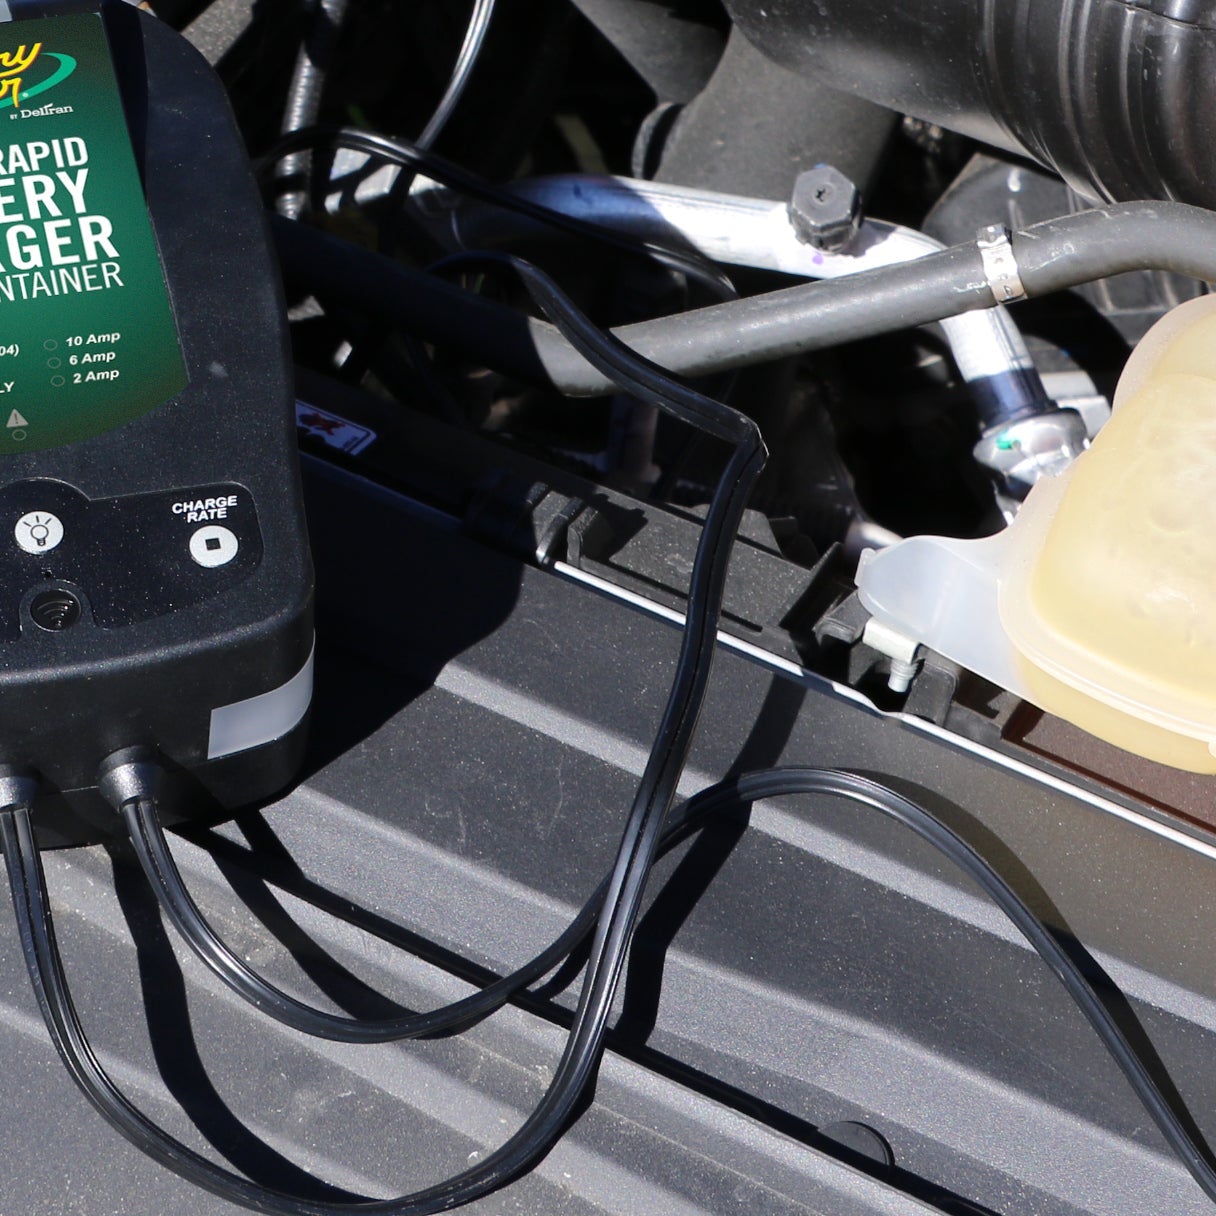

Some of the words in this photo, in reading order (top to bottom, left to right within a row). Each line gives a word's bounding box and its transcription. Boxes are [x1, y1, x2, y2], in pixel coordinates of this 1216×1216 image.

[65, 336, 83, 347] 10
[86, 332, 121, 346] Amp
[69, 355, 78, 365] 6
[82, 351, 116, 364] Amp
[73, 372, 82, 384] 2
[85, 369, 120, 383] Amp
[172, 495, 238, 515] CHARGE
[186, 507, 228, 524] RATE
